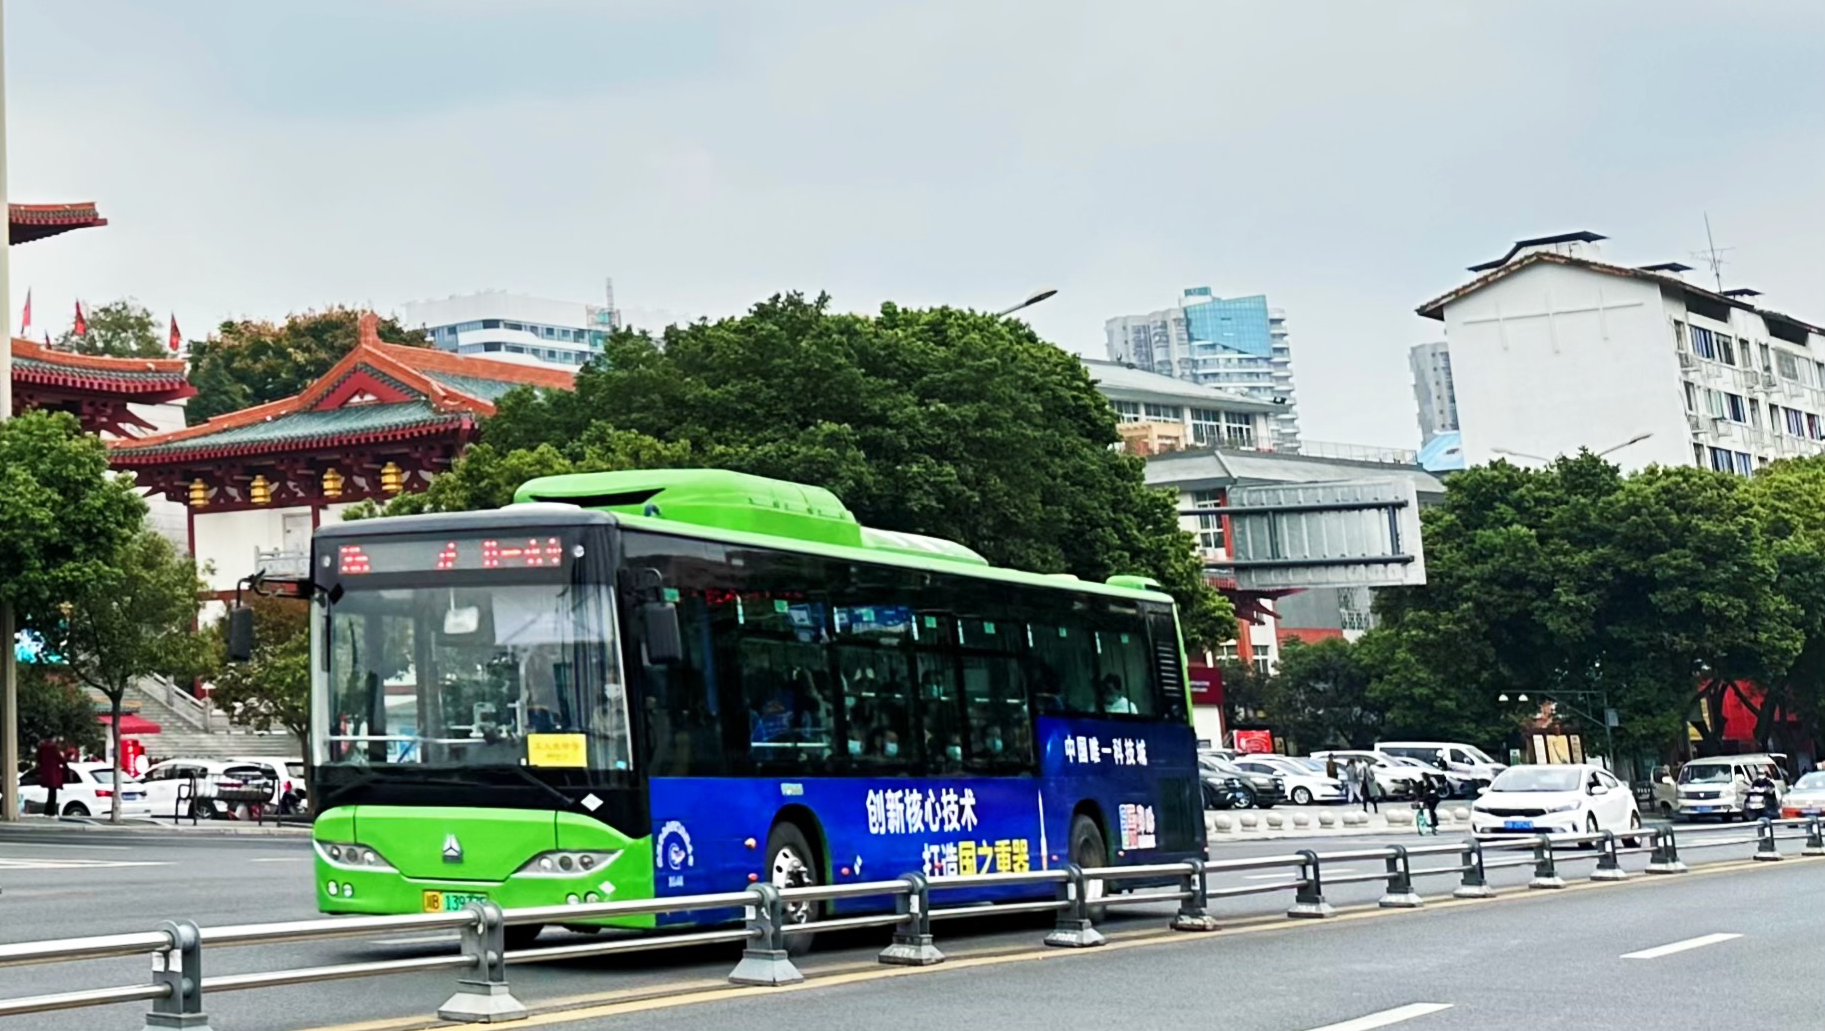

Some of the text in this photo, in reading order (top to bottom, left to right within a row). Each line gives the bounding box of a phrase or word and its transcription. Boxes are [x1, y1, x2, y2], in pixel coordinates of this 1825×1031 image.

[866, 788, 978, 834] 创新核心技术
[922, 839, 1030, 876] 打造国之重器
